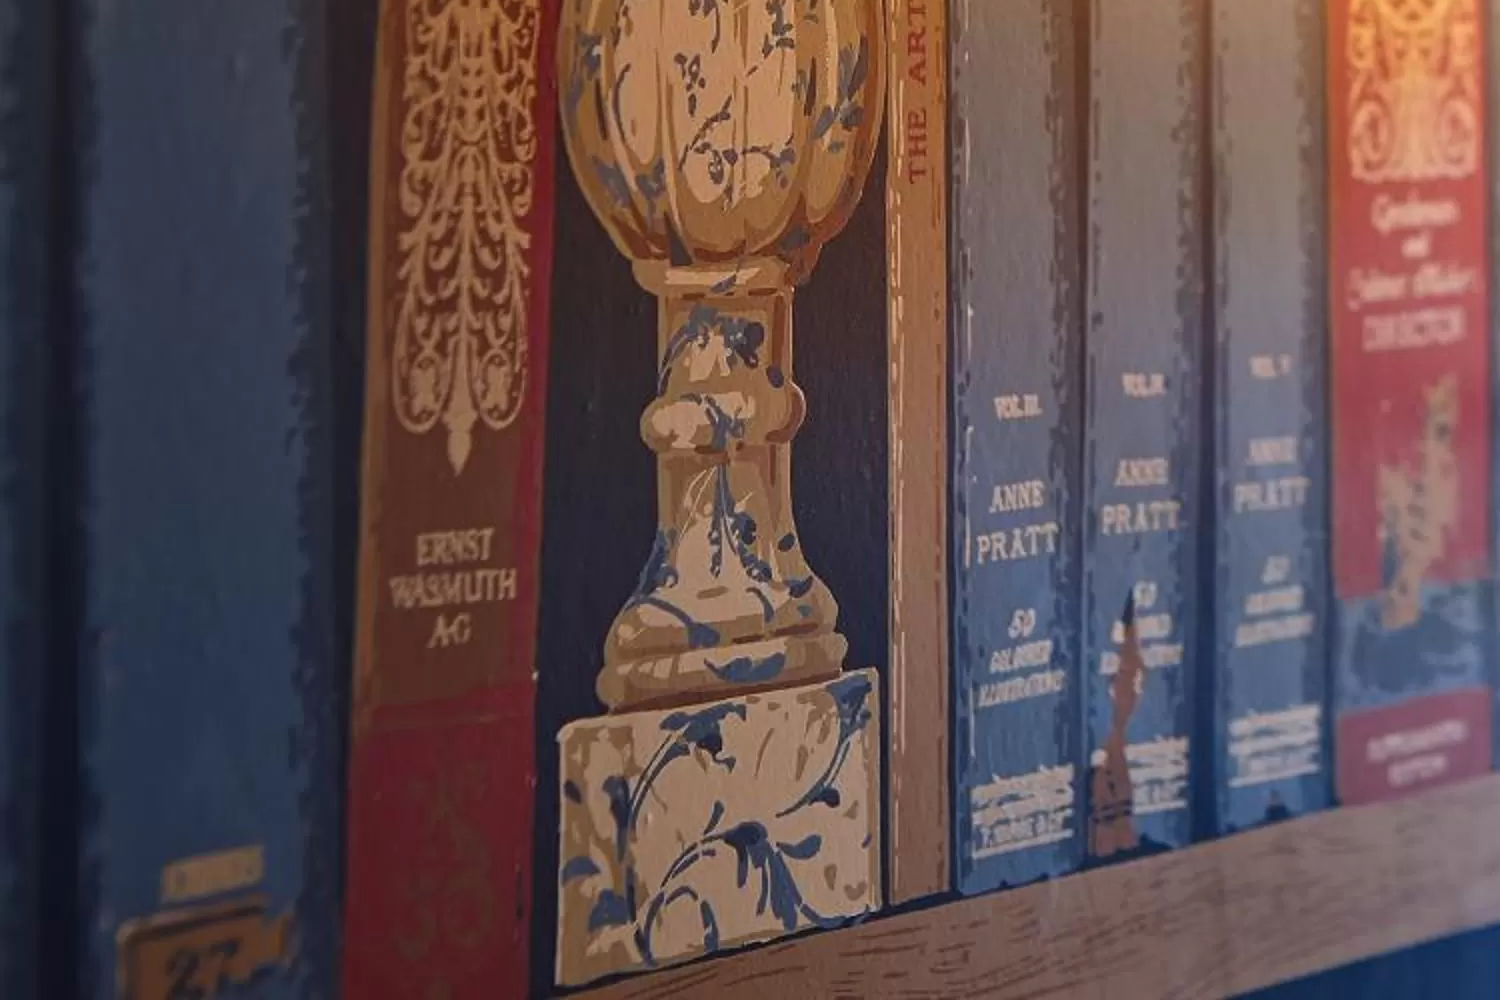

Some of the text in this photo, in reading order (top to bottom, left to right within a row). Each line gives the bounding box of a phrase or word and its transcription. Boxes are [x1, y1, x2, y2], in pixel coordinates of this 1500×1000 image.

[907, 106, 928, 185] THE
[989, 480, 1045, 514] ANNE
[1102, 500, 1182, 536] PRATT
[416, 527, 495, 567] ERNST
[976, 521, 1059, 565] PRATT
[388, 567, 518, 609] WASMUTH
